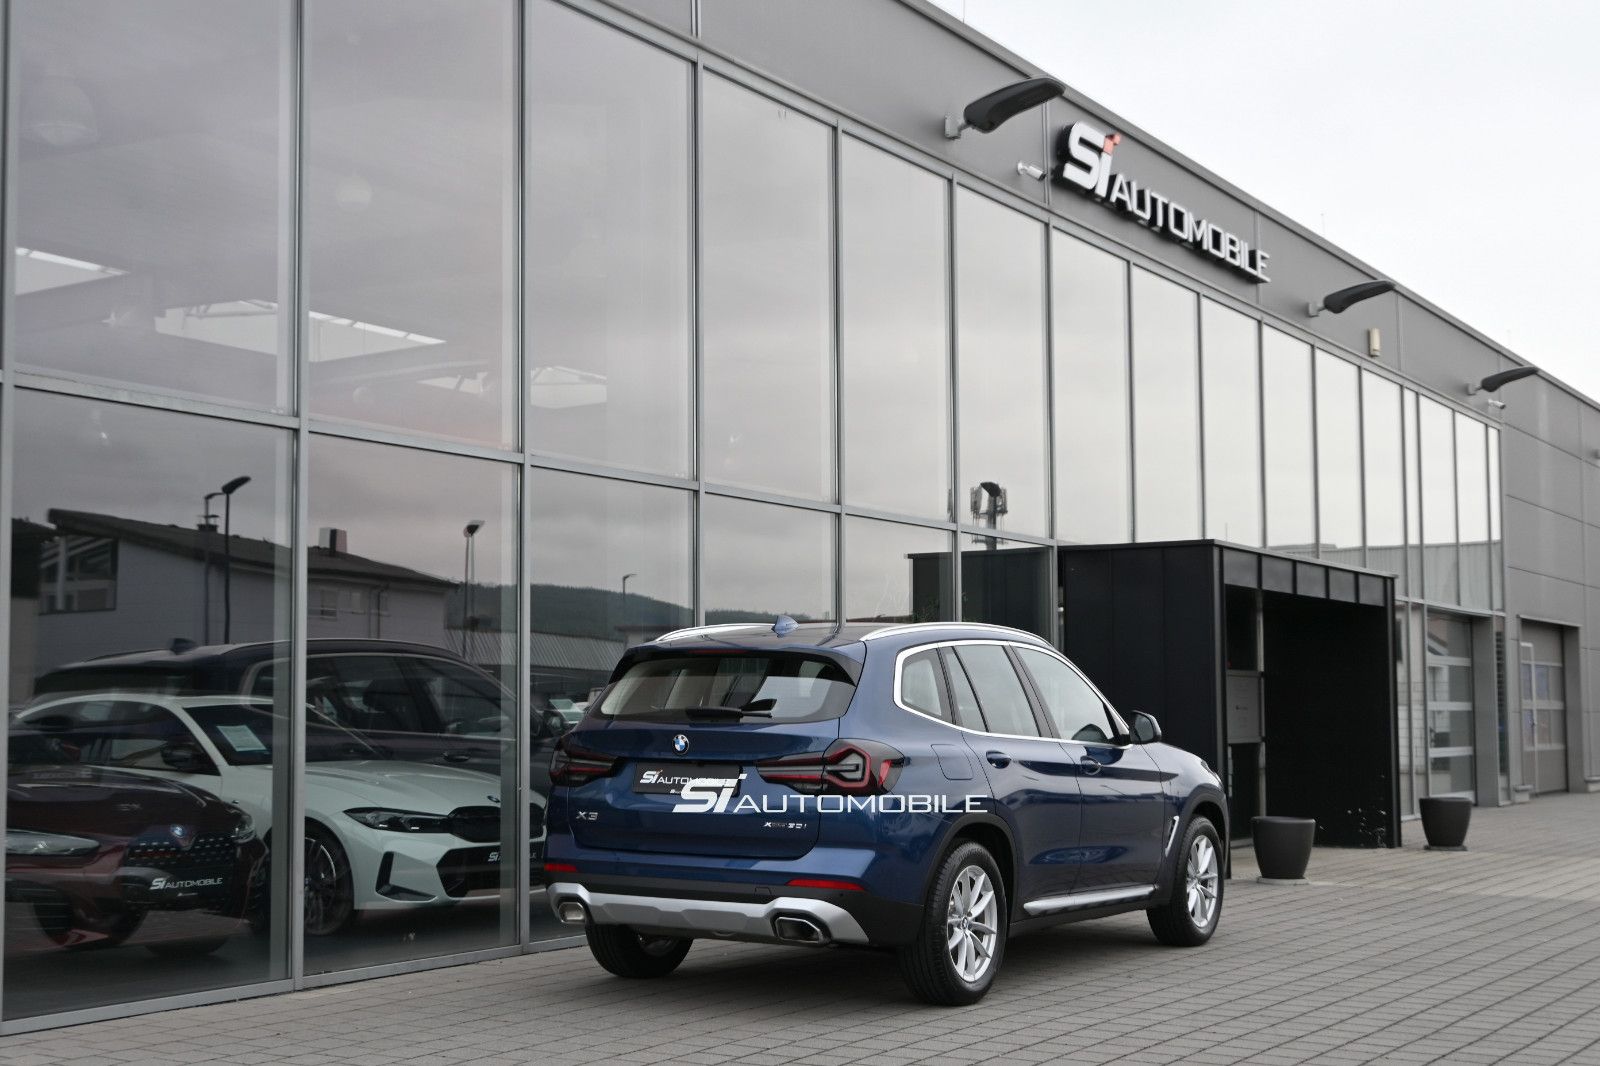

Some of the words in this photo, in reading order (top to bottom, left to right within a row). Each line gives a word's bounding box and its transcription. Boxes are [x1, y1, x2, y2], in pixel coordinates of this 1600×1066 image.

[1110, 174, 1271, 283] AUTOMOBILE
[576, 811, 598, 820] X3
[165, 878, 223, 889] AUTOMOBILE
